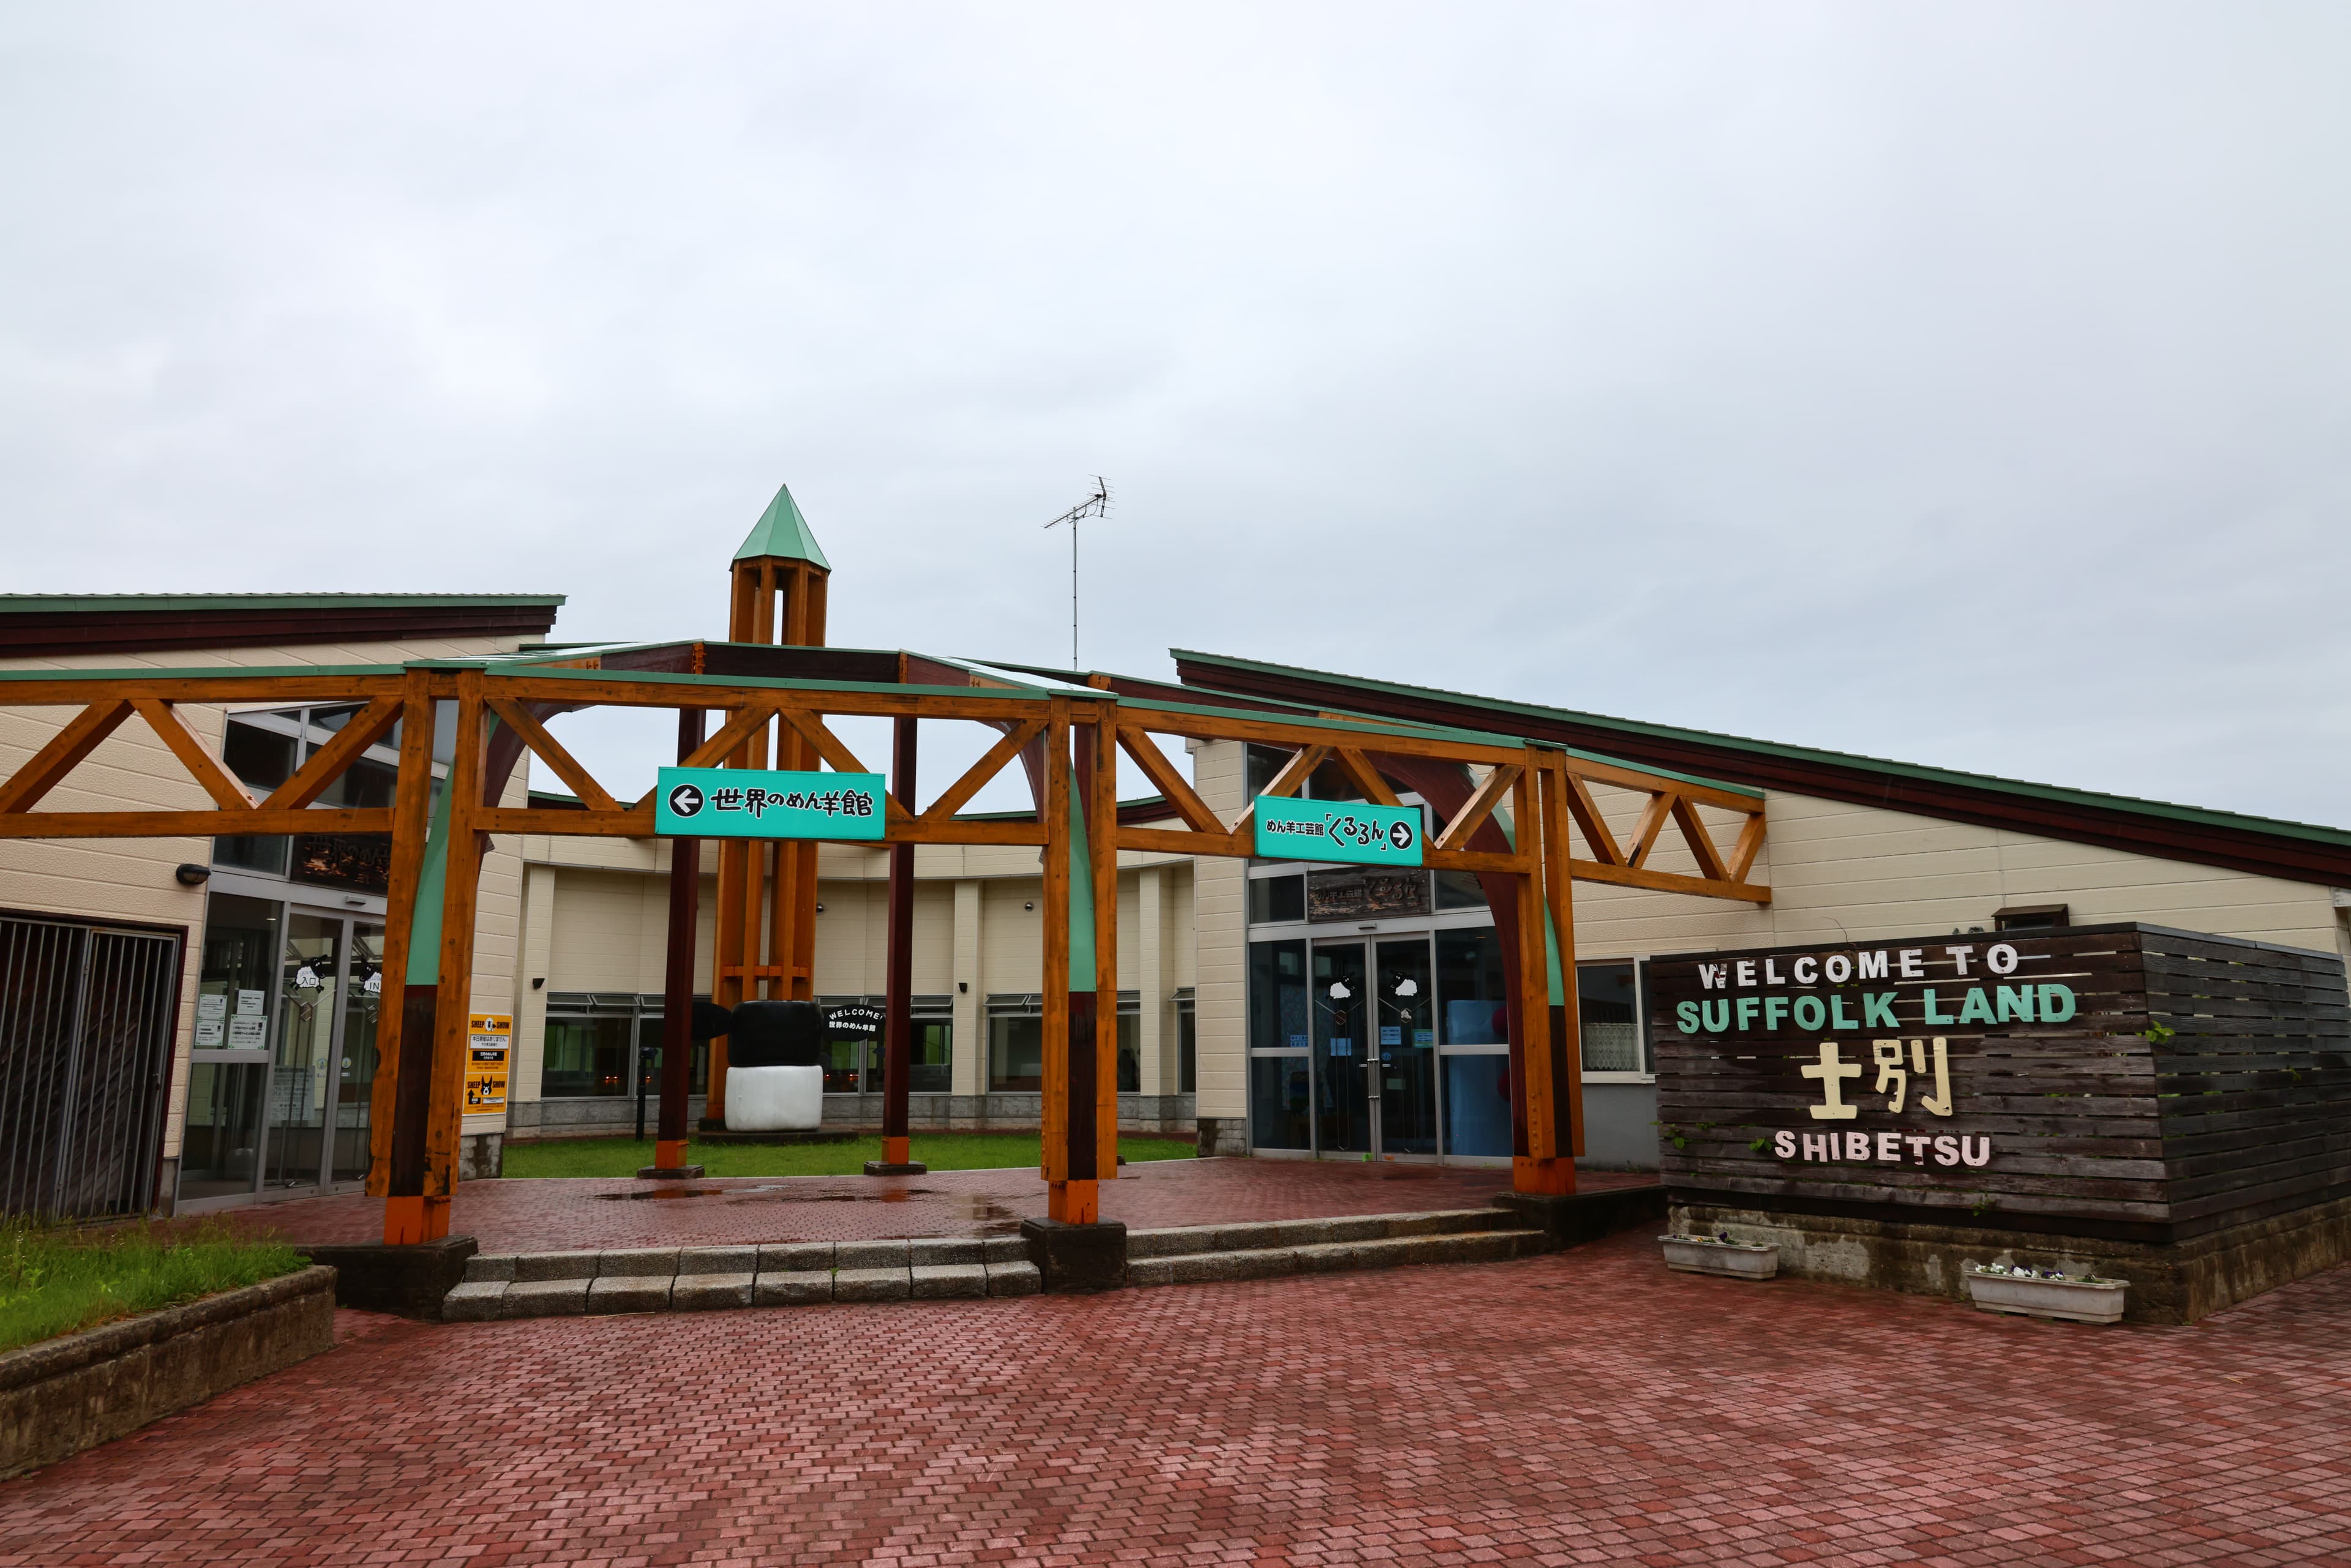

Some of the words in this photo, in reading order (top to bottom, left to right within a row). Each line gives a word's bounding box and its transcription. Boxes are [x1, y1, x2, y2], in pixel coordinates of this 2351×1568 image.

[710, 788, 873, 819] 世界のめん羊館
[301, 977, 316, 985] 入口
[1698, 949, 1924, 989] WELCOME
[1946, 943, 2018, 975] TO
[829, 1009, 883, 1021] WELCOME!
[1677, 991, 1900, 1033] SUFFOLK
[1924, 984, 2076, 1025] LAND
[829, 1021, 876, 1032] 世界のめん羊館
[1801, 1037, 1952, 1119] 士別
[1774, 1130, 1990, 1166] SHIBETSU
